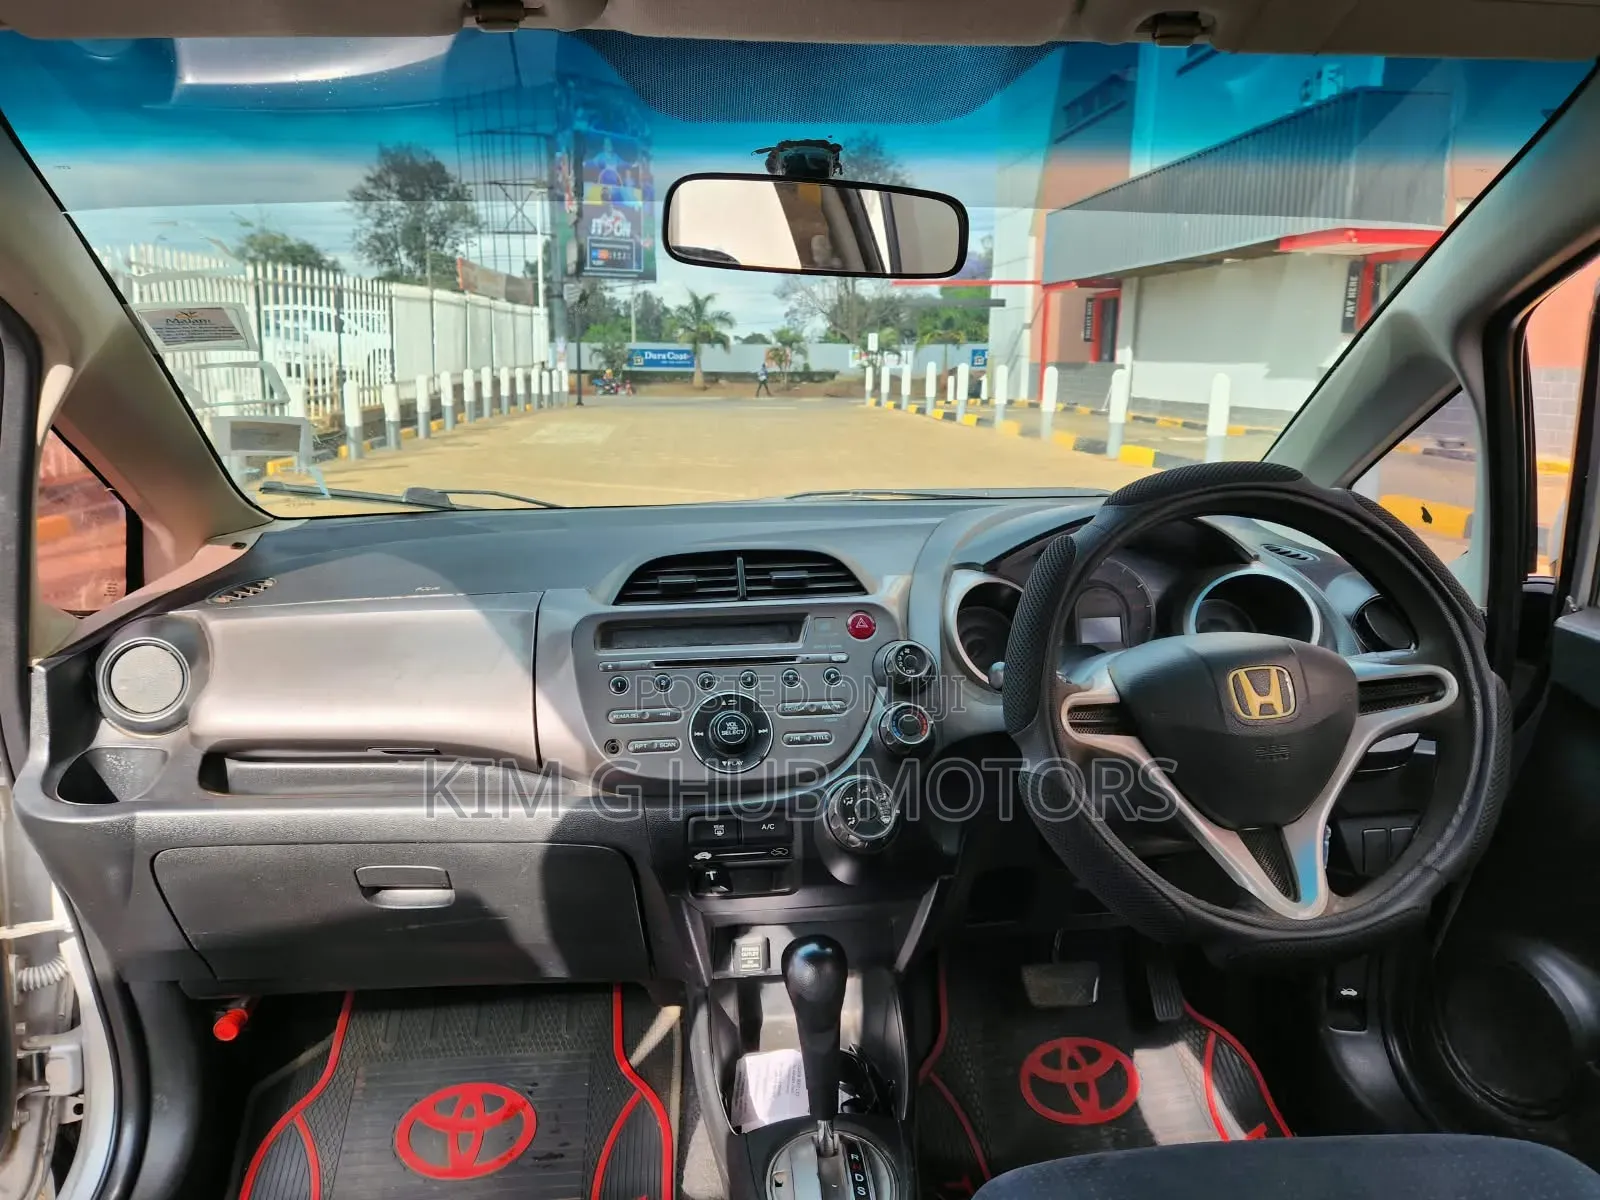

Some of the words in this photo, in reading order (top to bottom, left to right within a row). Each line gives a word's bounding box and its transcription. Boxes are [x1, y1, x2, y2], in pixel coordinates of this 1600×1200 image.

[1347, 276, 1358, 299] HERE
[1345, 300, 1356, 318] PAY
[850, 1153, 859, 1161] R
[855, 1173, 864, 1182] D
[857, 1186, 867, 1196] S
